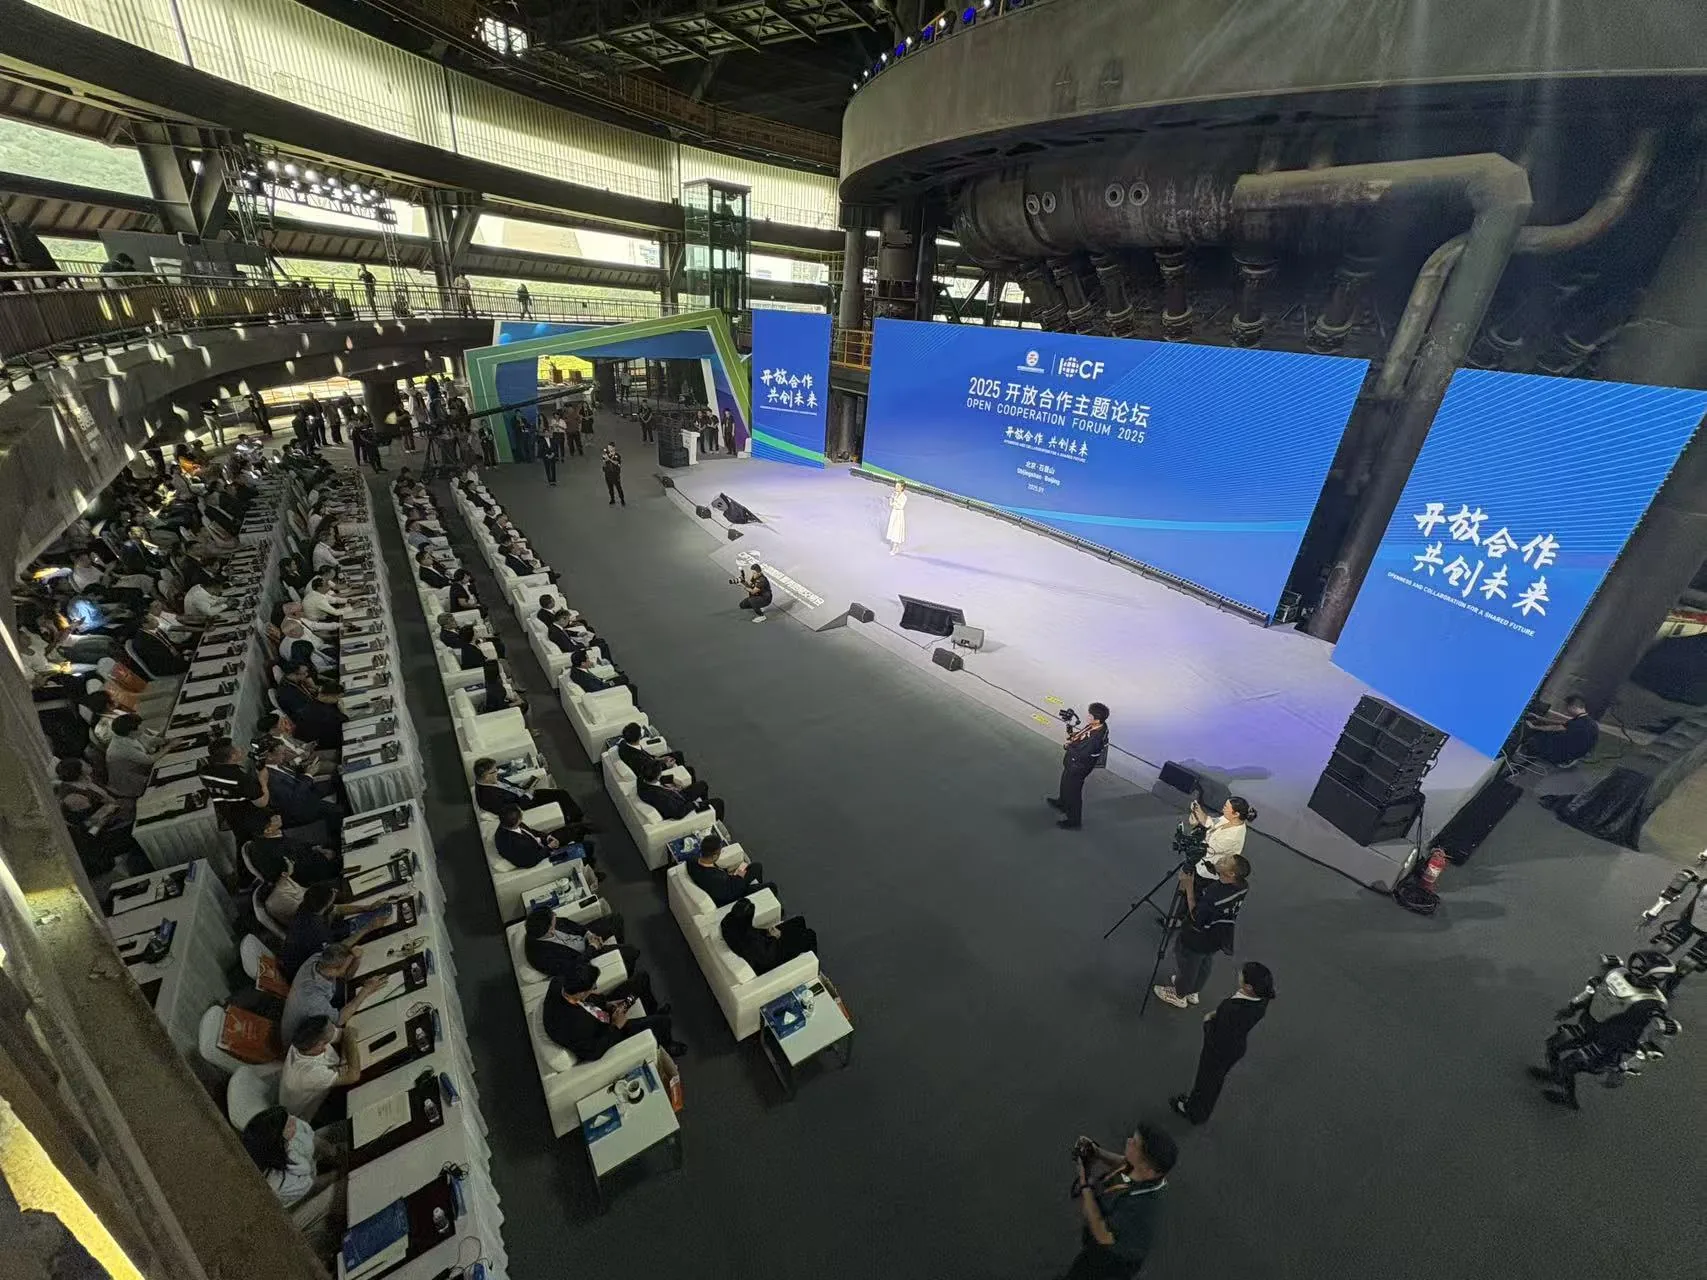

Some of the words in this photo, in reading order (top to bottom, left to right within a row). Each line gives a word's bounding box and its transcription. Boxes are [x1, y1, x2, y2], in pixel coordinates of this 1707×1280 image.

[760, 367, 814, 390] 开放合作
[767, 386, 818, 409] 共创未来
[966, 397, 992, 412] OPEN
[997, 402, 1066, 427] COOPERATION
[1071, 417, 1112, 436] FORUM
[1116, 427, 1145, 444] 2025
[968, 376, 1002, 399] 2025
[1005, 382, 1150, 429] 开放合作主题论坛
[1005, 425, 1044, 446] 开放合作
[1048, 435, 1088, 457] 共创未来
[1413, 502, 1561, 571] 开放合作
[1412, 540, 1550, 617] 共创未来
[1466, 604, 1479, 614] FOR
[1484, 611, 1509, 626] SHARED
[1509, 621, 1536, 637] FUTURE
